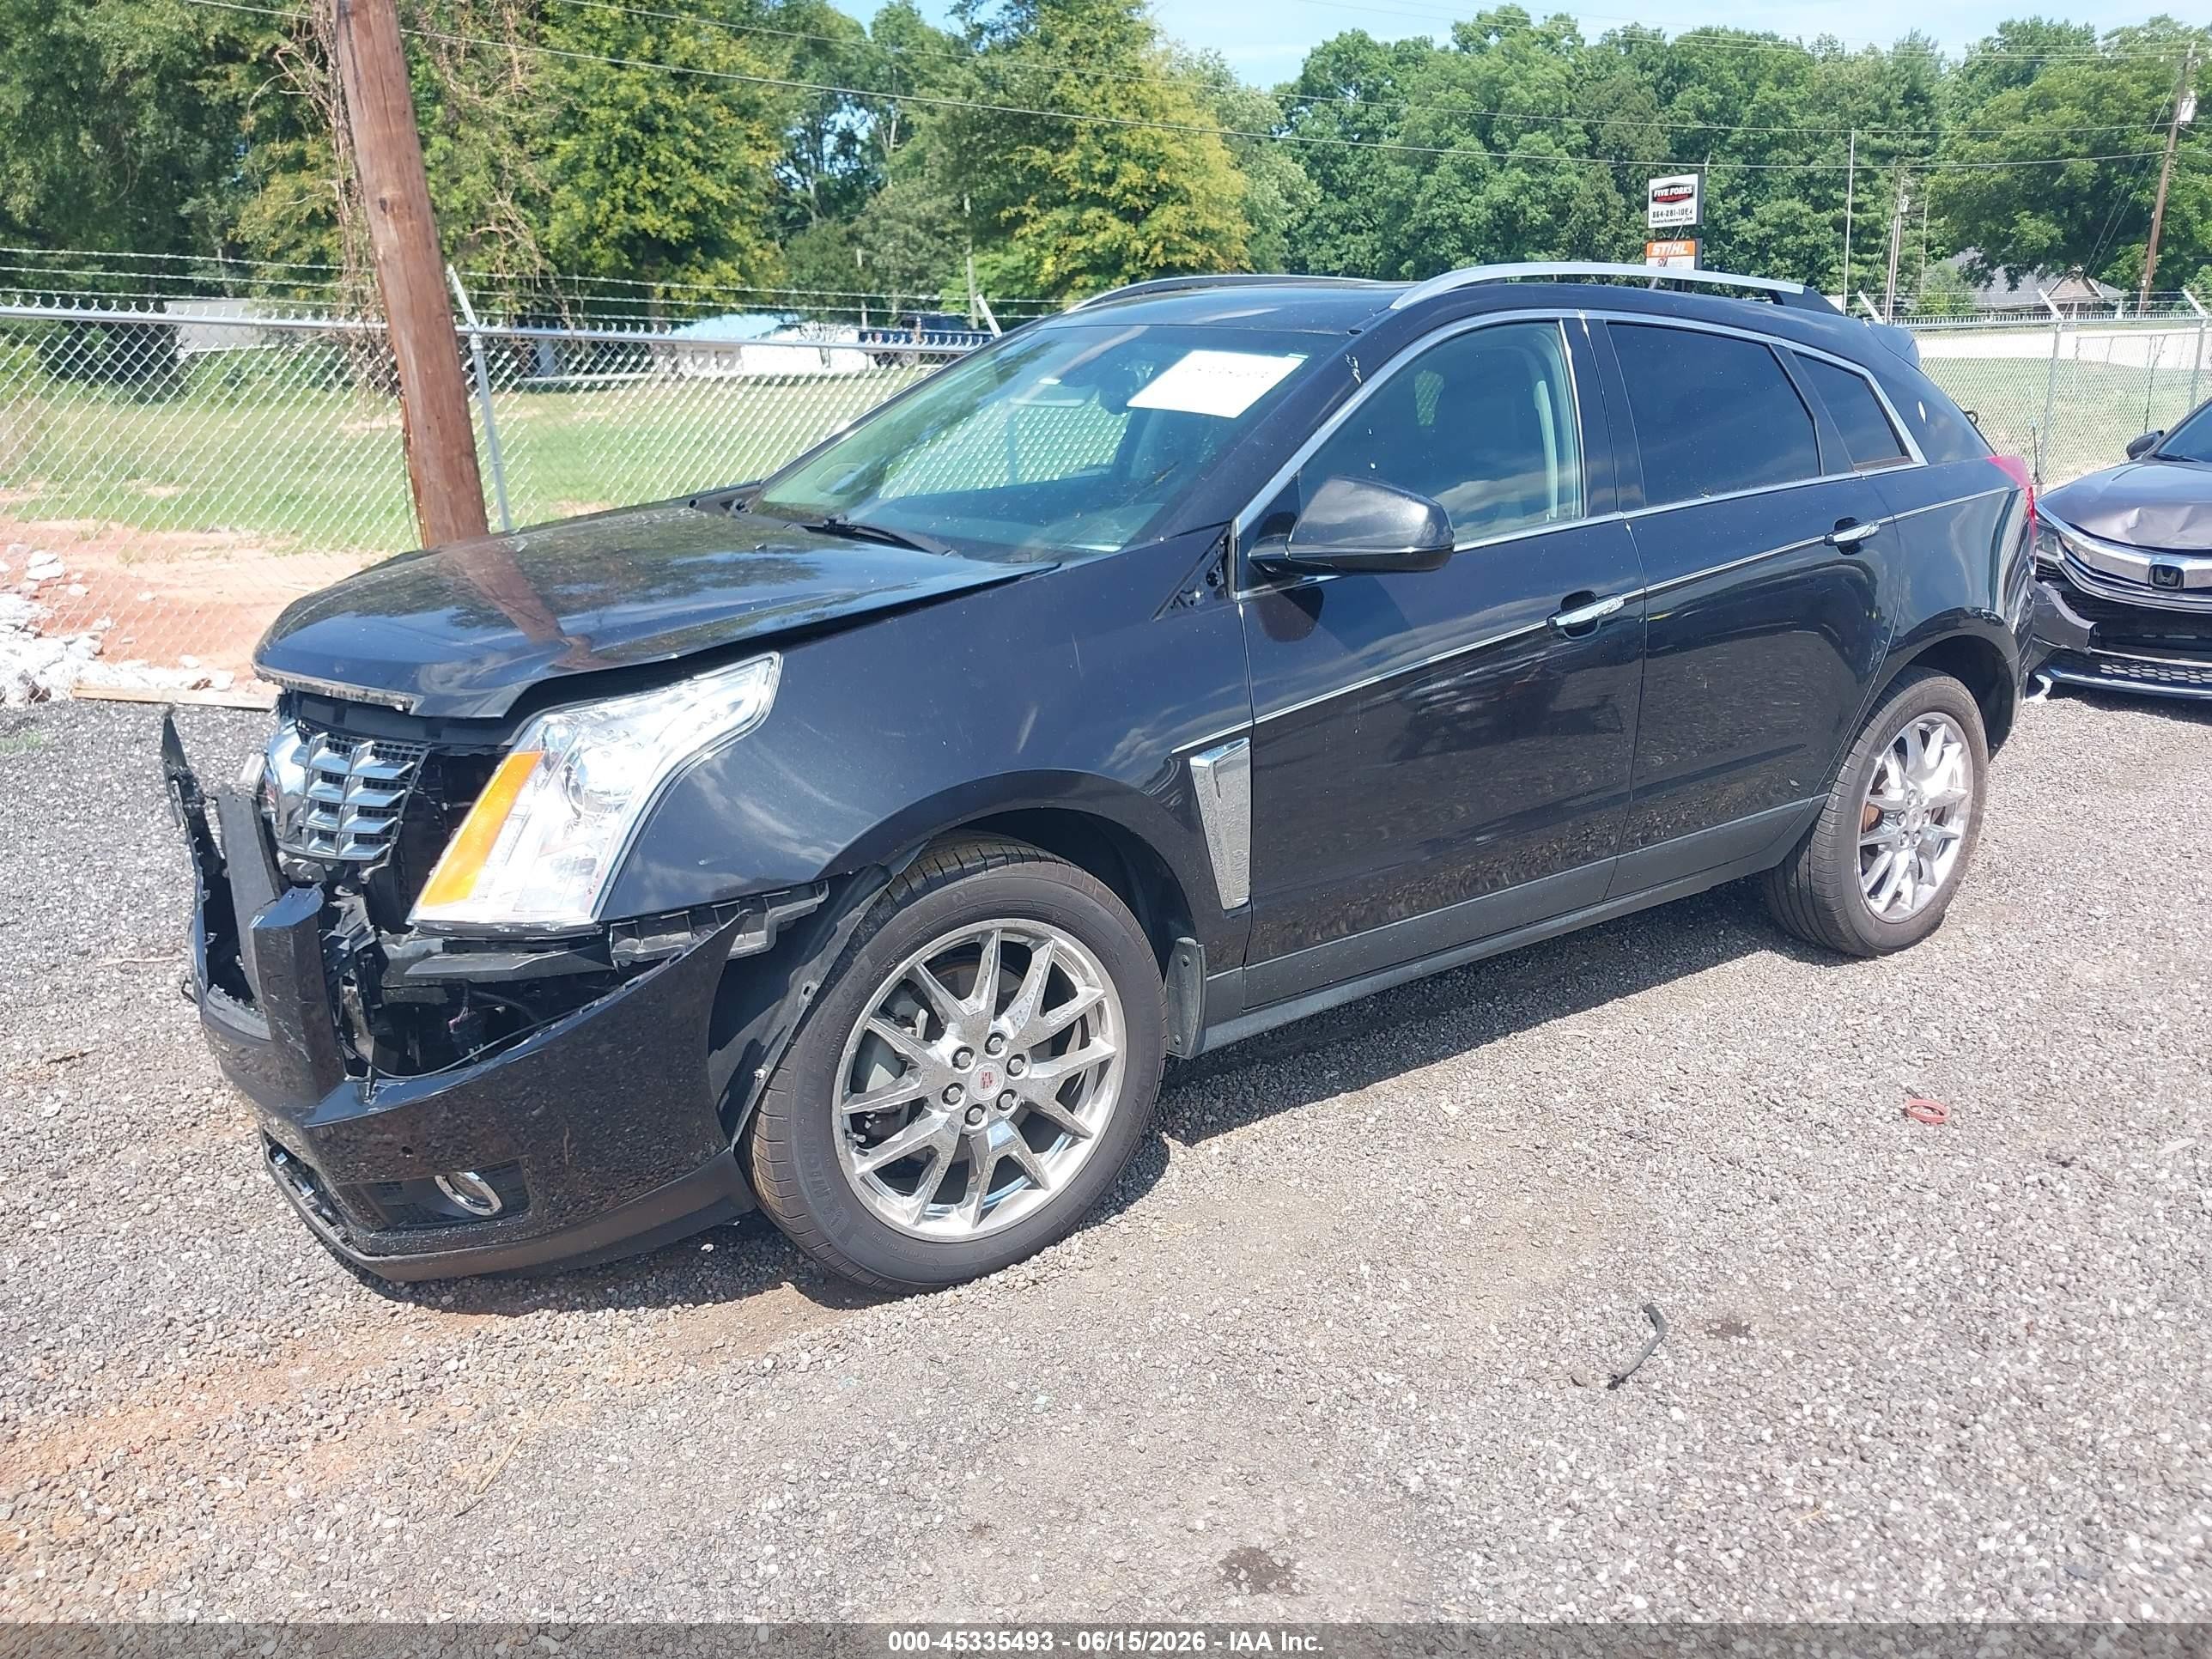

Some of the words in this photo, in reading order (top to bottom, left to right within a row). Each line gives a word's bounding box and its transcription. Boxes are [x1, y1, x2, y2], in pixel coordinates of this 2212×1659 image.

[1654, 188, 1670, 198] FIVE
[1669, 185, 1692, 196] FORKS
[1651, 242, 1688, 256] STIHL
